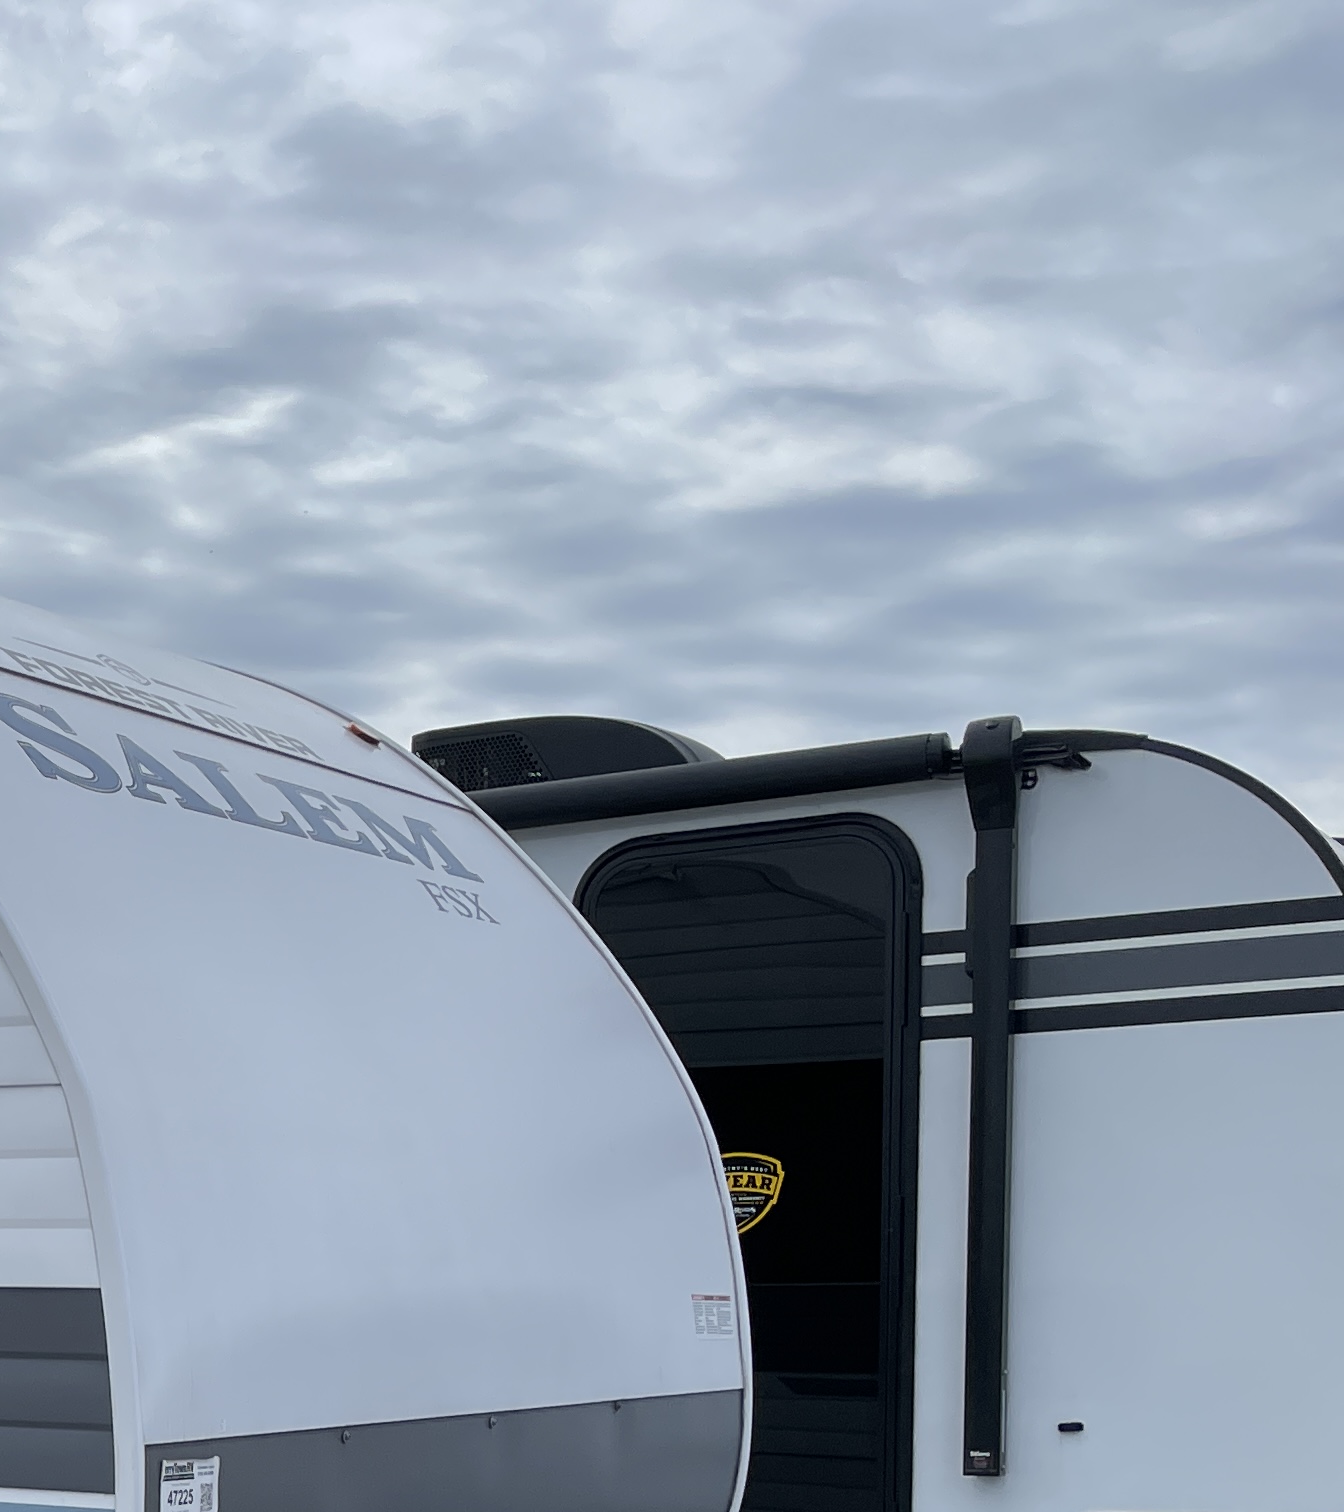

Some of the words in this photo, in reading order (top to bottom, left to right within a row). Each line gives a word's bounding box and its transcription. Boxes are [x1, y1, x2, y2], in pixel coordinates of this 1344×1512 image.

[184, 703, 325, 761] RIVER
[417, 878, 500, 925] FSX
[167, 1489, 194, 1506] 47225
